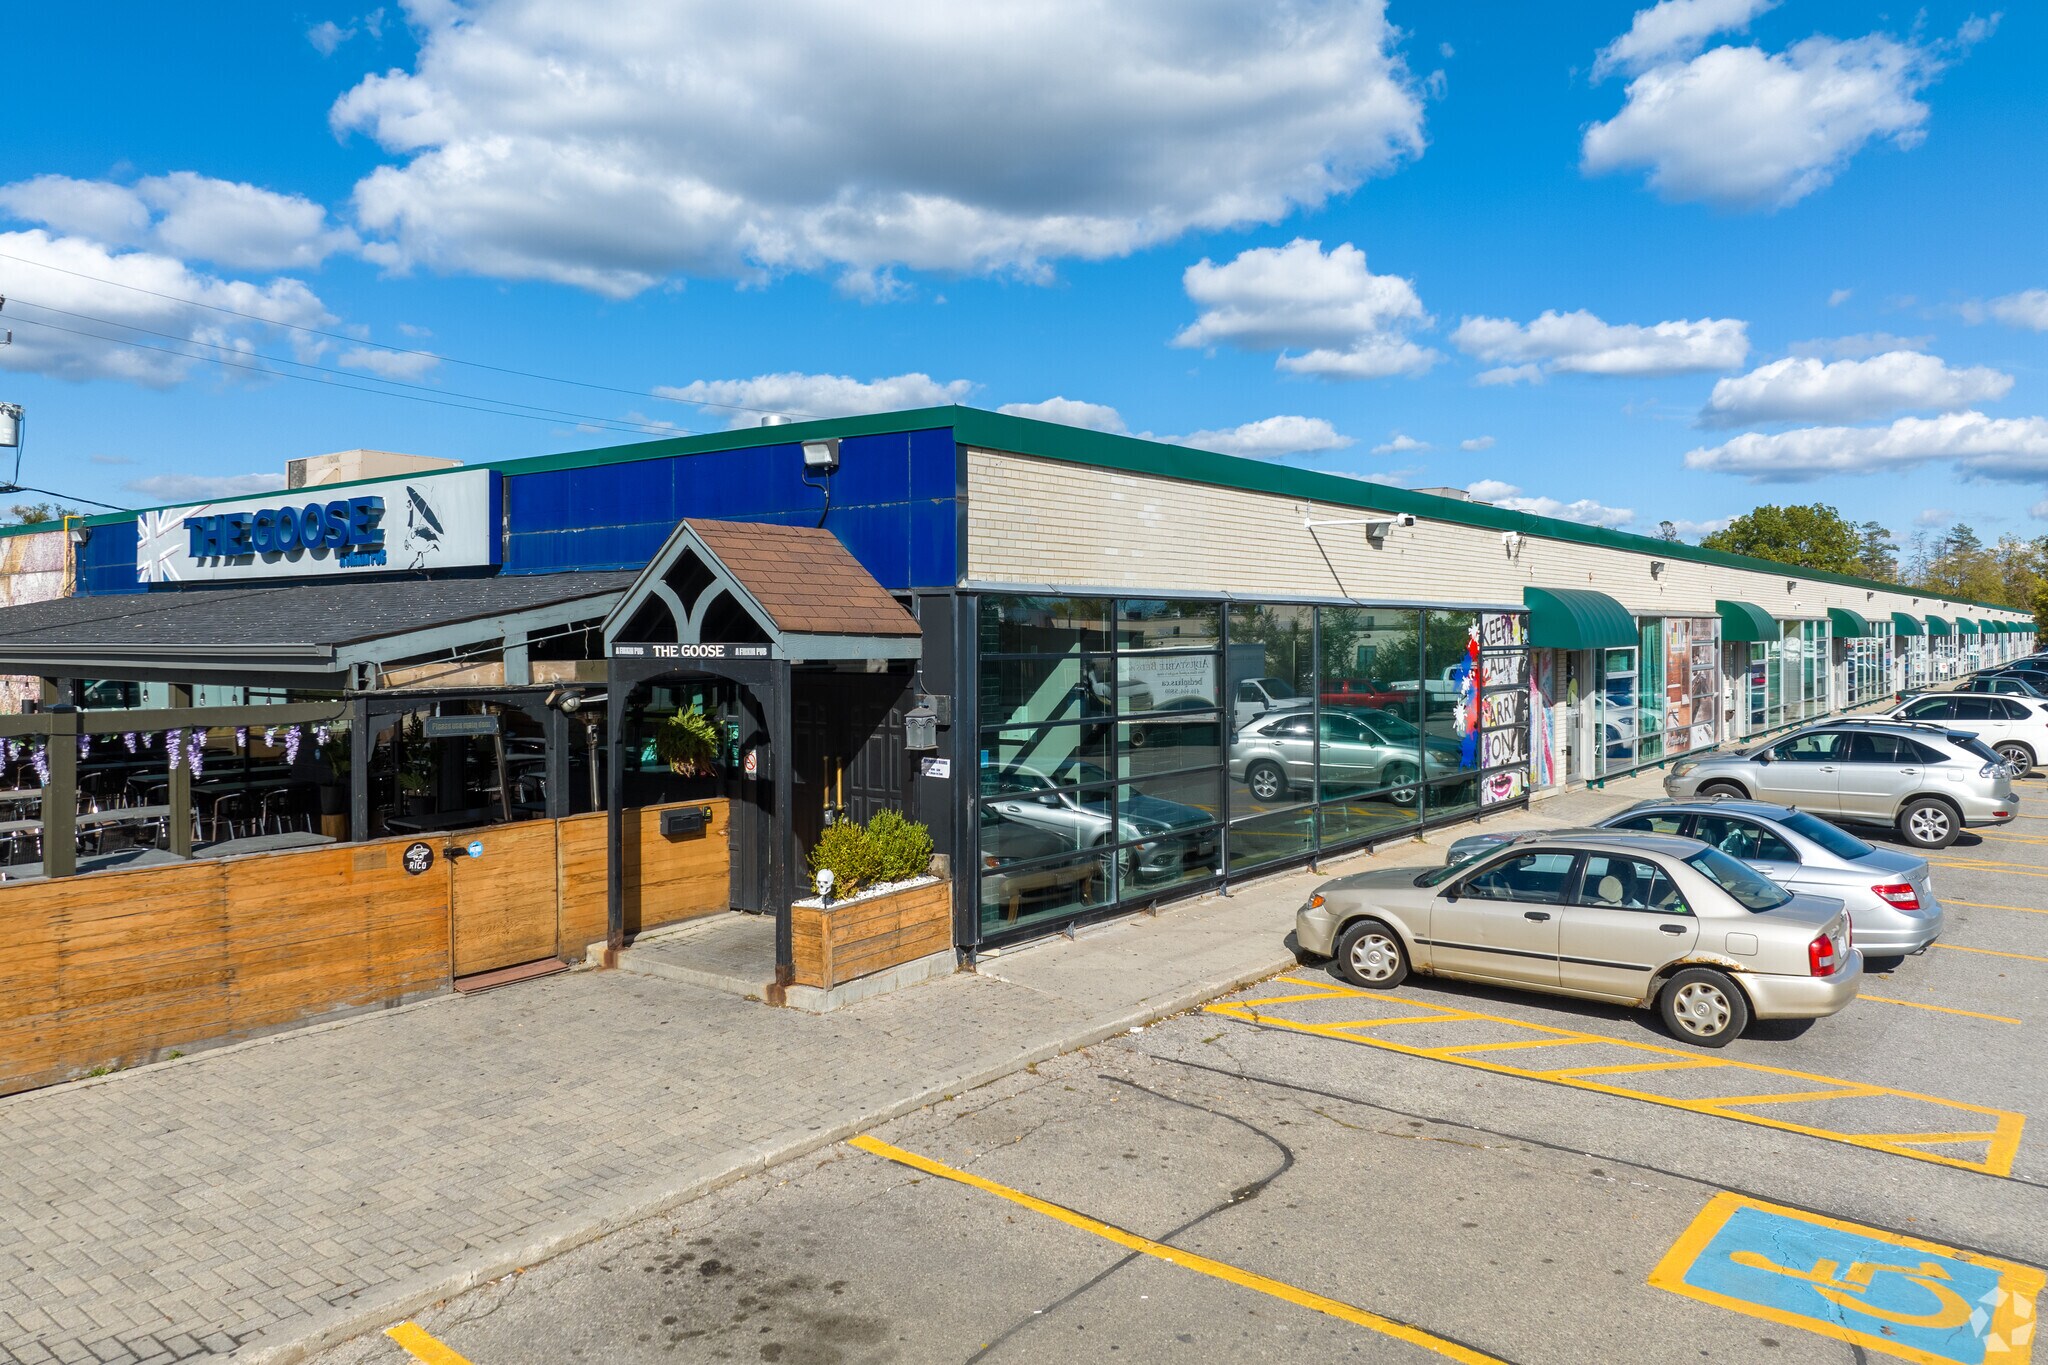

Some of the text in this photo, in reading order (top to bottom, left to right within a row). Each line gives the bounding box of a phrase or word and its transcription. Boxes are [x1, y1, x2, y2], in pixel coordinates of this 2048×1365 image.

[183, 496, 384, 558] THE GOOSE
[1482, 614, 1507, 646] KEEP
[653, 645, 725, 658] THE GOOSE
[409, 861, 427, 870] RICO
